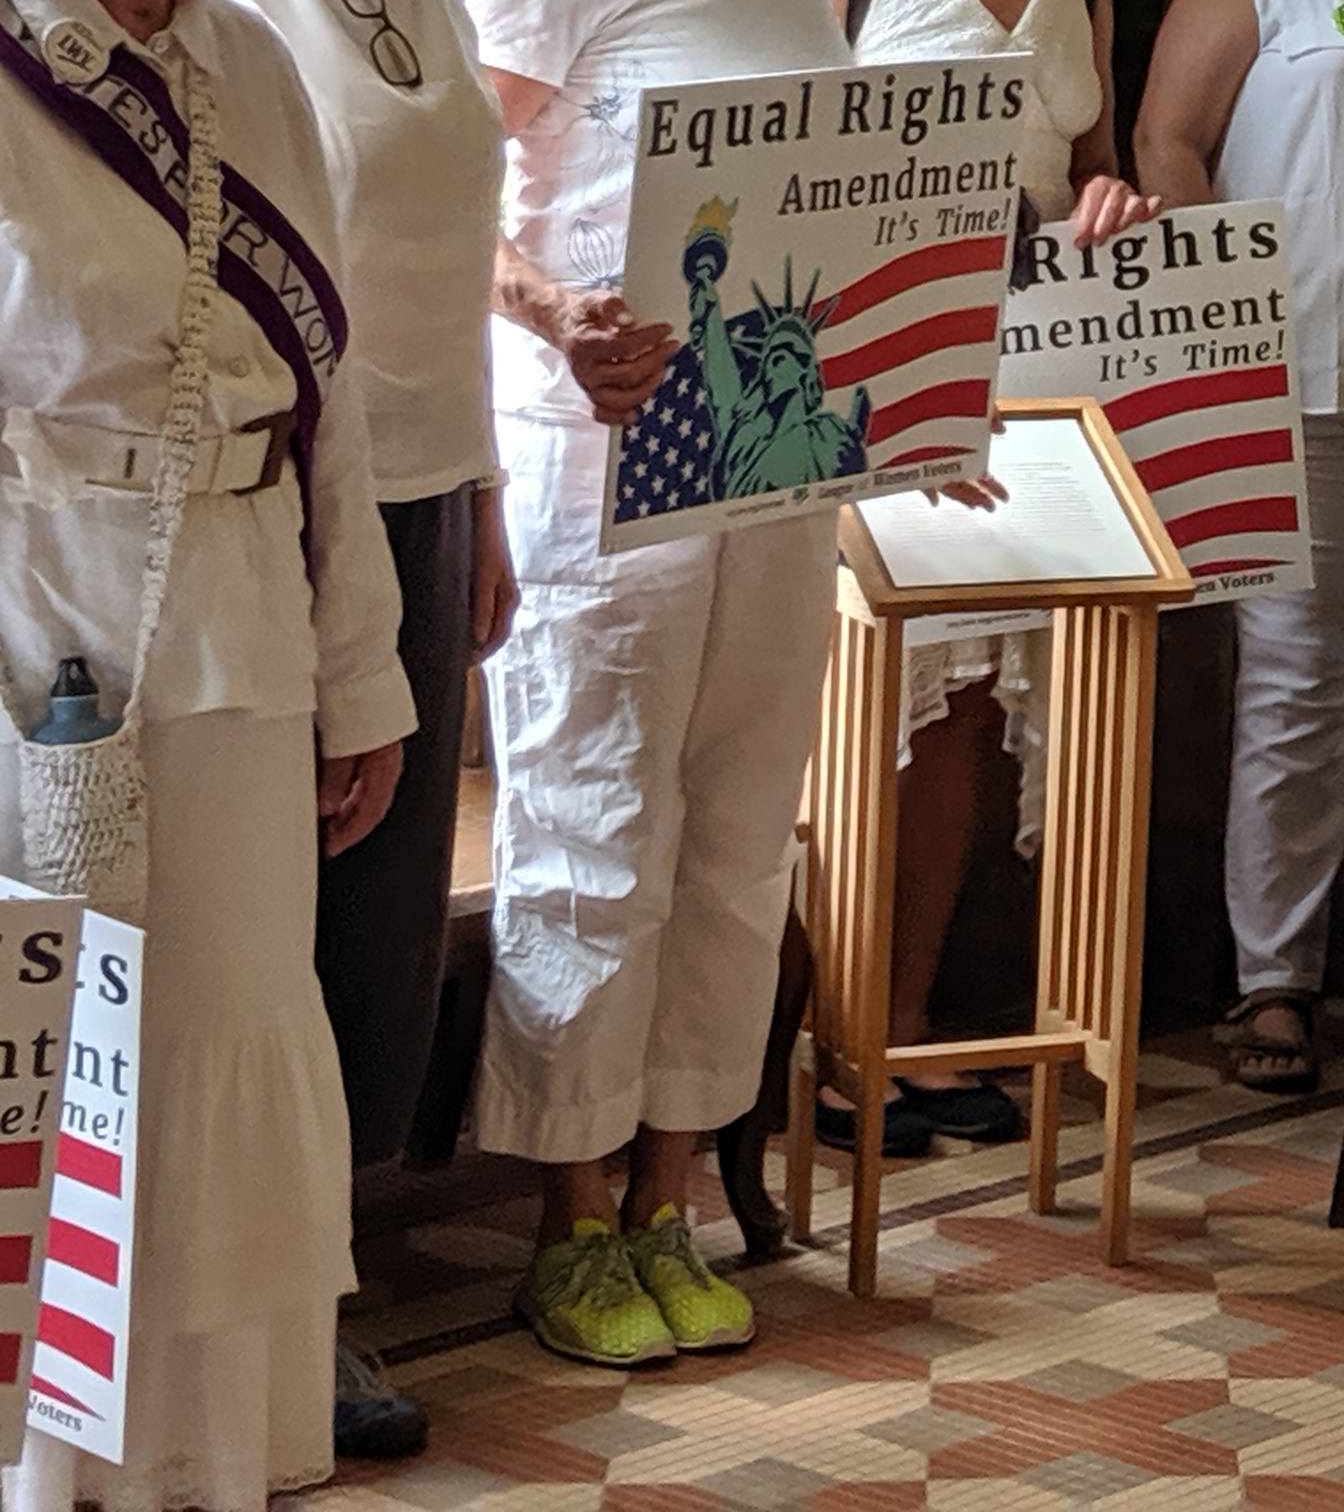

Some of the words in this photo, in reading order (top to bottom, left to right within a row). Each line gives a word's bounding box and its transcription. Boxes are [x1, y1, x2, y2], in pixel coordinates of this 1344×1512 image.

[647, 80, 814, 169] Equal
[838, 68, 1025, 145] Rights
[163, 158, 269, 267] FR
[777, 150, 1018, 216] Amendment
[873, 211, 919, 246] It's
[936, 198, 1012, 238] Time!
[1027, 217, 1280, 290] Rights
[1000, 288, 1288, 356] mendment
[1098, 349, 1159, 383] It's
[1182, 329, 1285, 372] Time!
[1218, 572, 1275, 591] Voters
